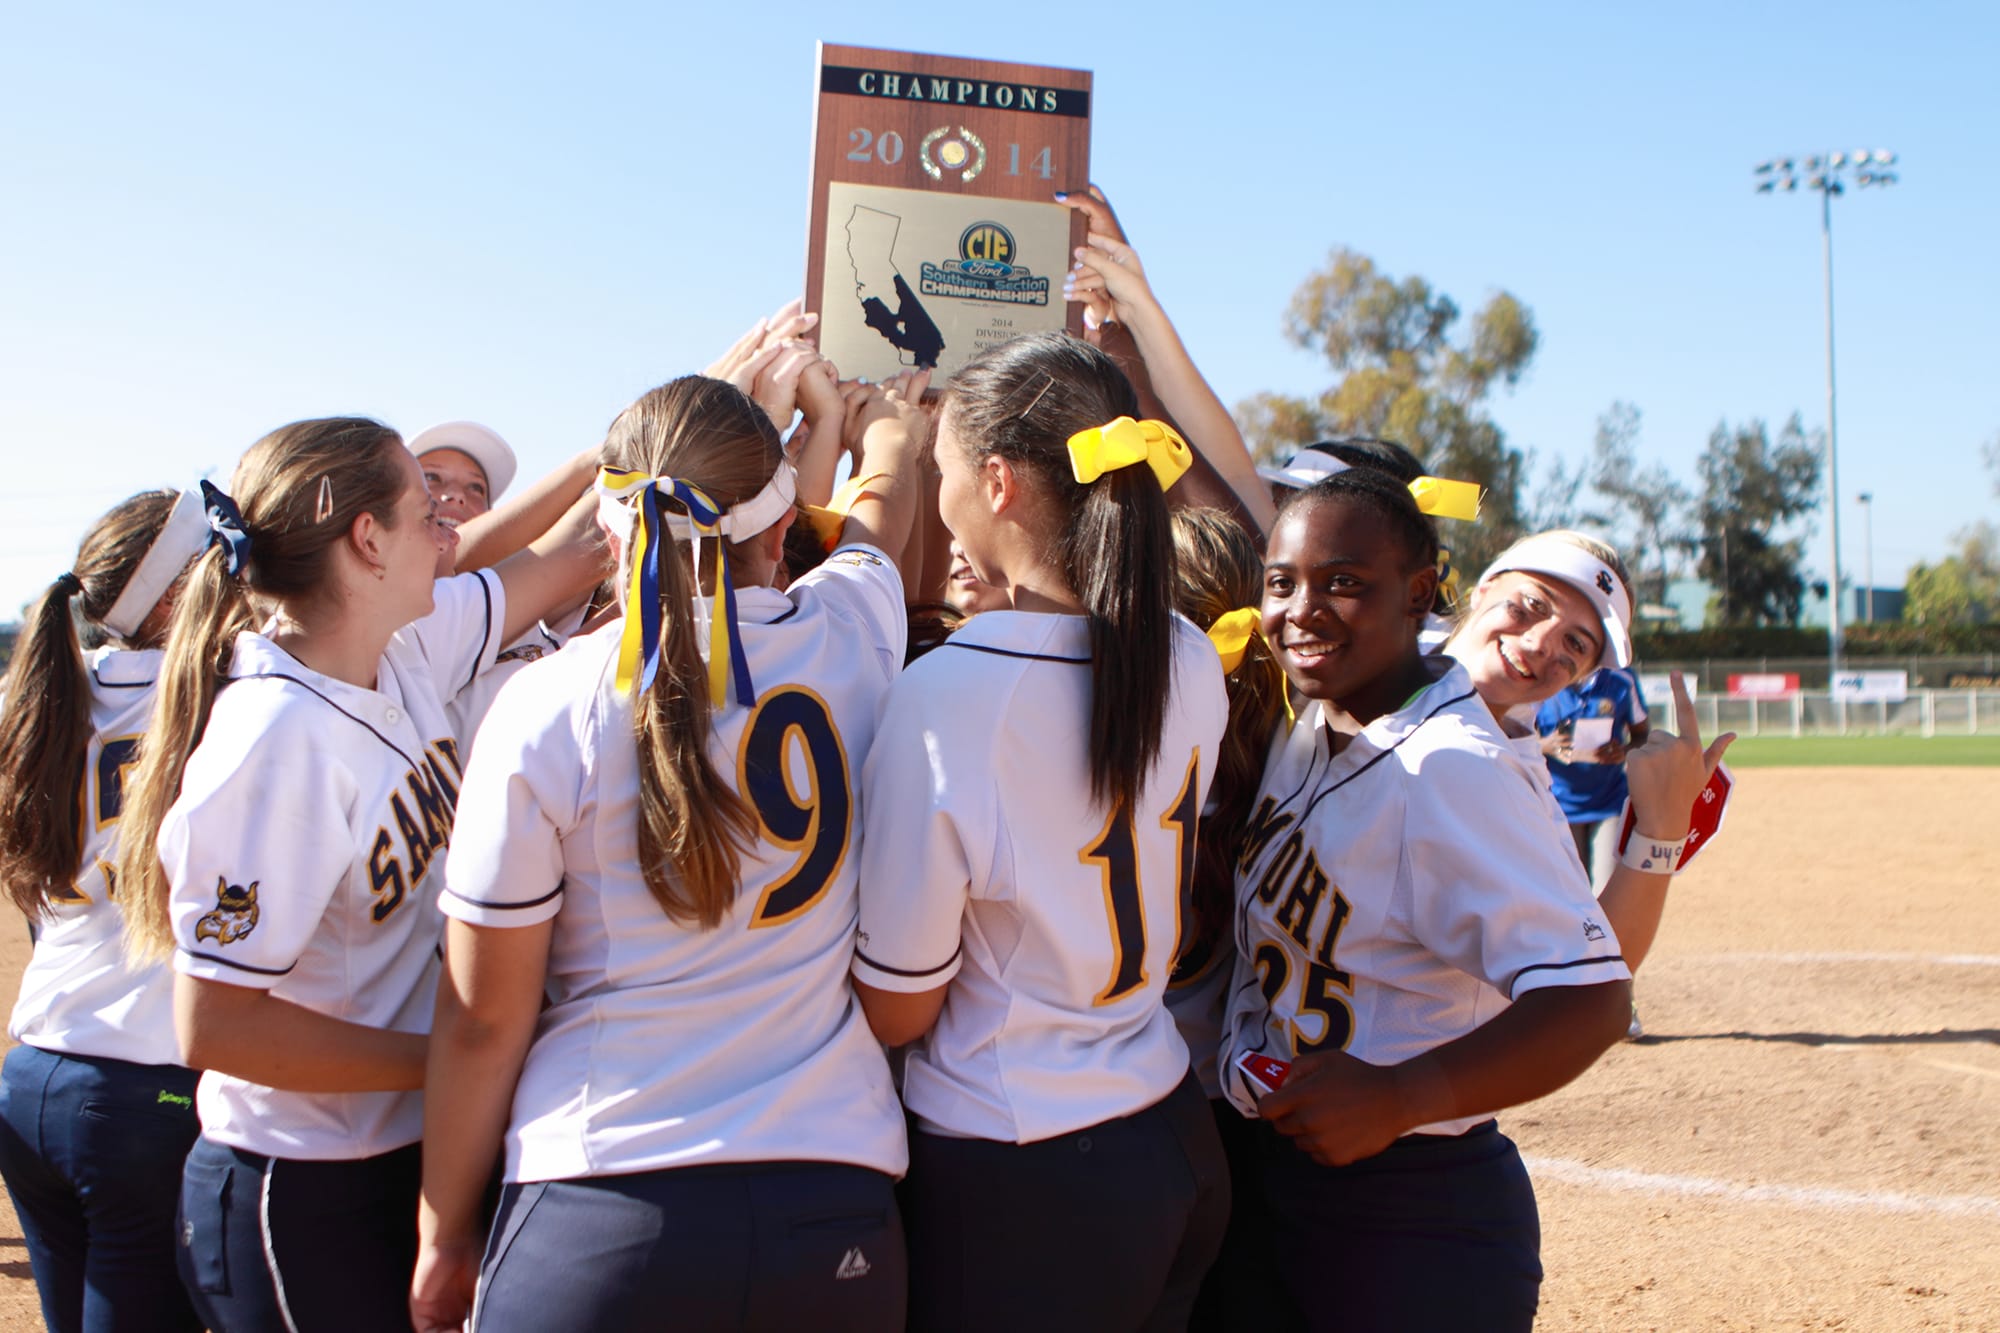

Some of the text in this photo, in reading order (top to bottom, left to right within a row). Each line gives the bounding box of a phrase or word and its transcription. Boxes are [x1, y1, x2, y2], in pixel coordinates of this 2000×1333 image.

[858, 72, 1058, 112] CHAMPIONS
[847, 128, 1057, 179] 20 14
[966, 228, 1009, 260] CIF
[922, 264, 988, 289] Southern
[995, 277, 1047, 292] Section
[969, 261, 1004, 277] Ford
[921, 280, 1047, 304] CHAMPIONSHIPS
[991, 318, 1013, 327] 2014
[737, 683, 853, 930] 9
[1078, 745, 1200, 1007] 11
